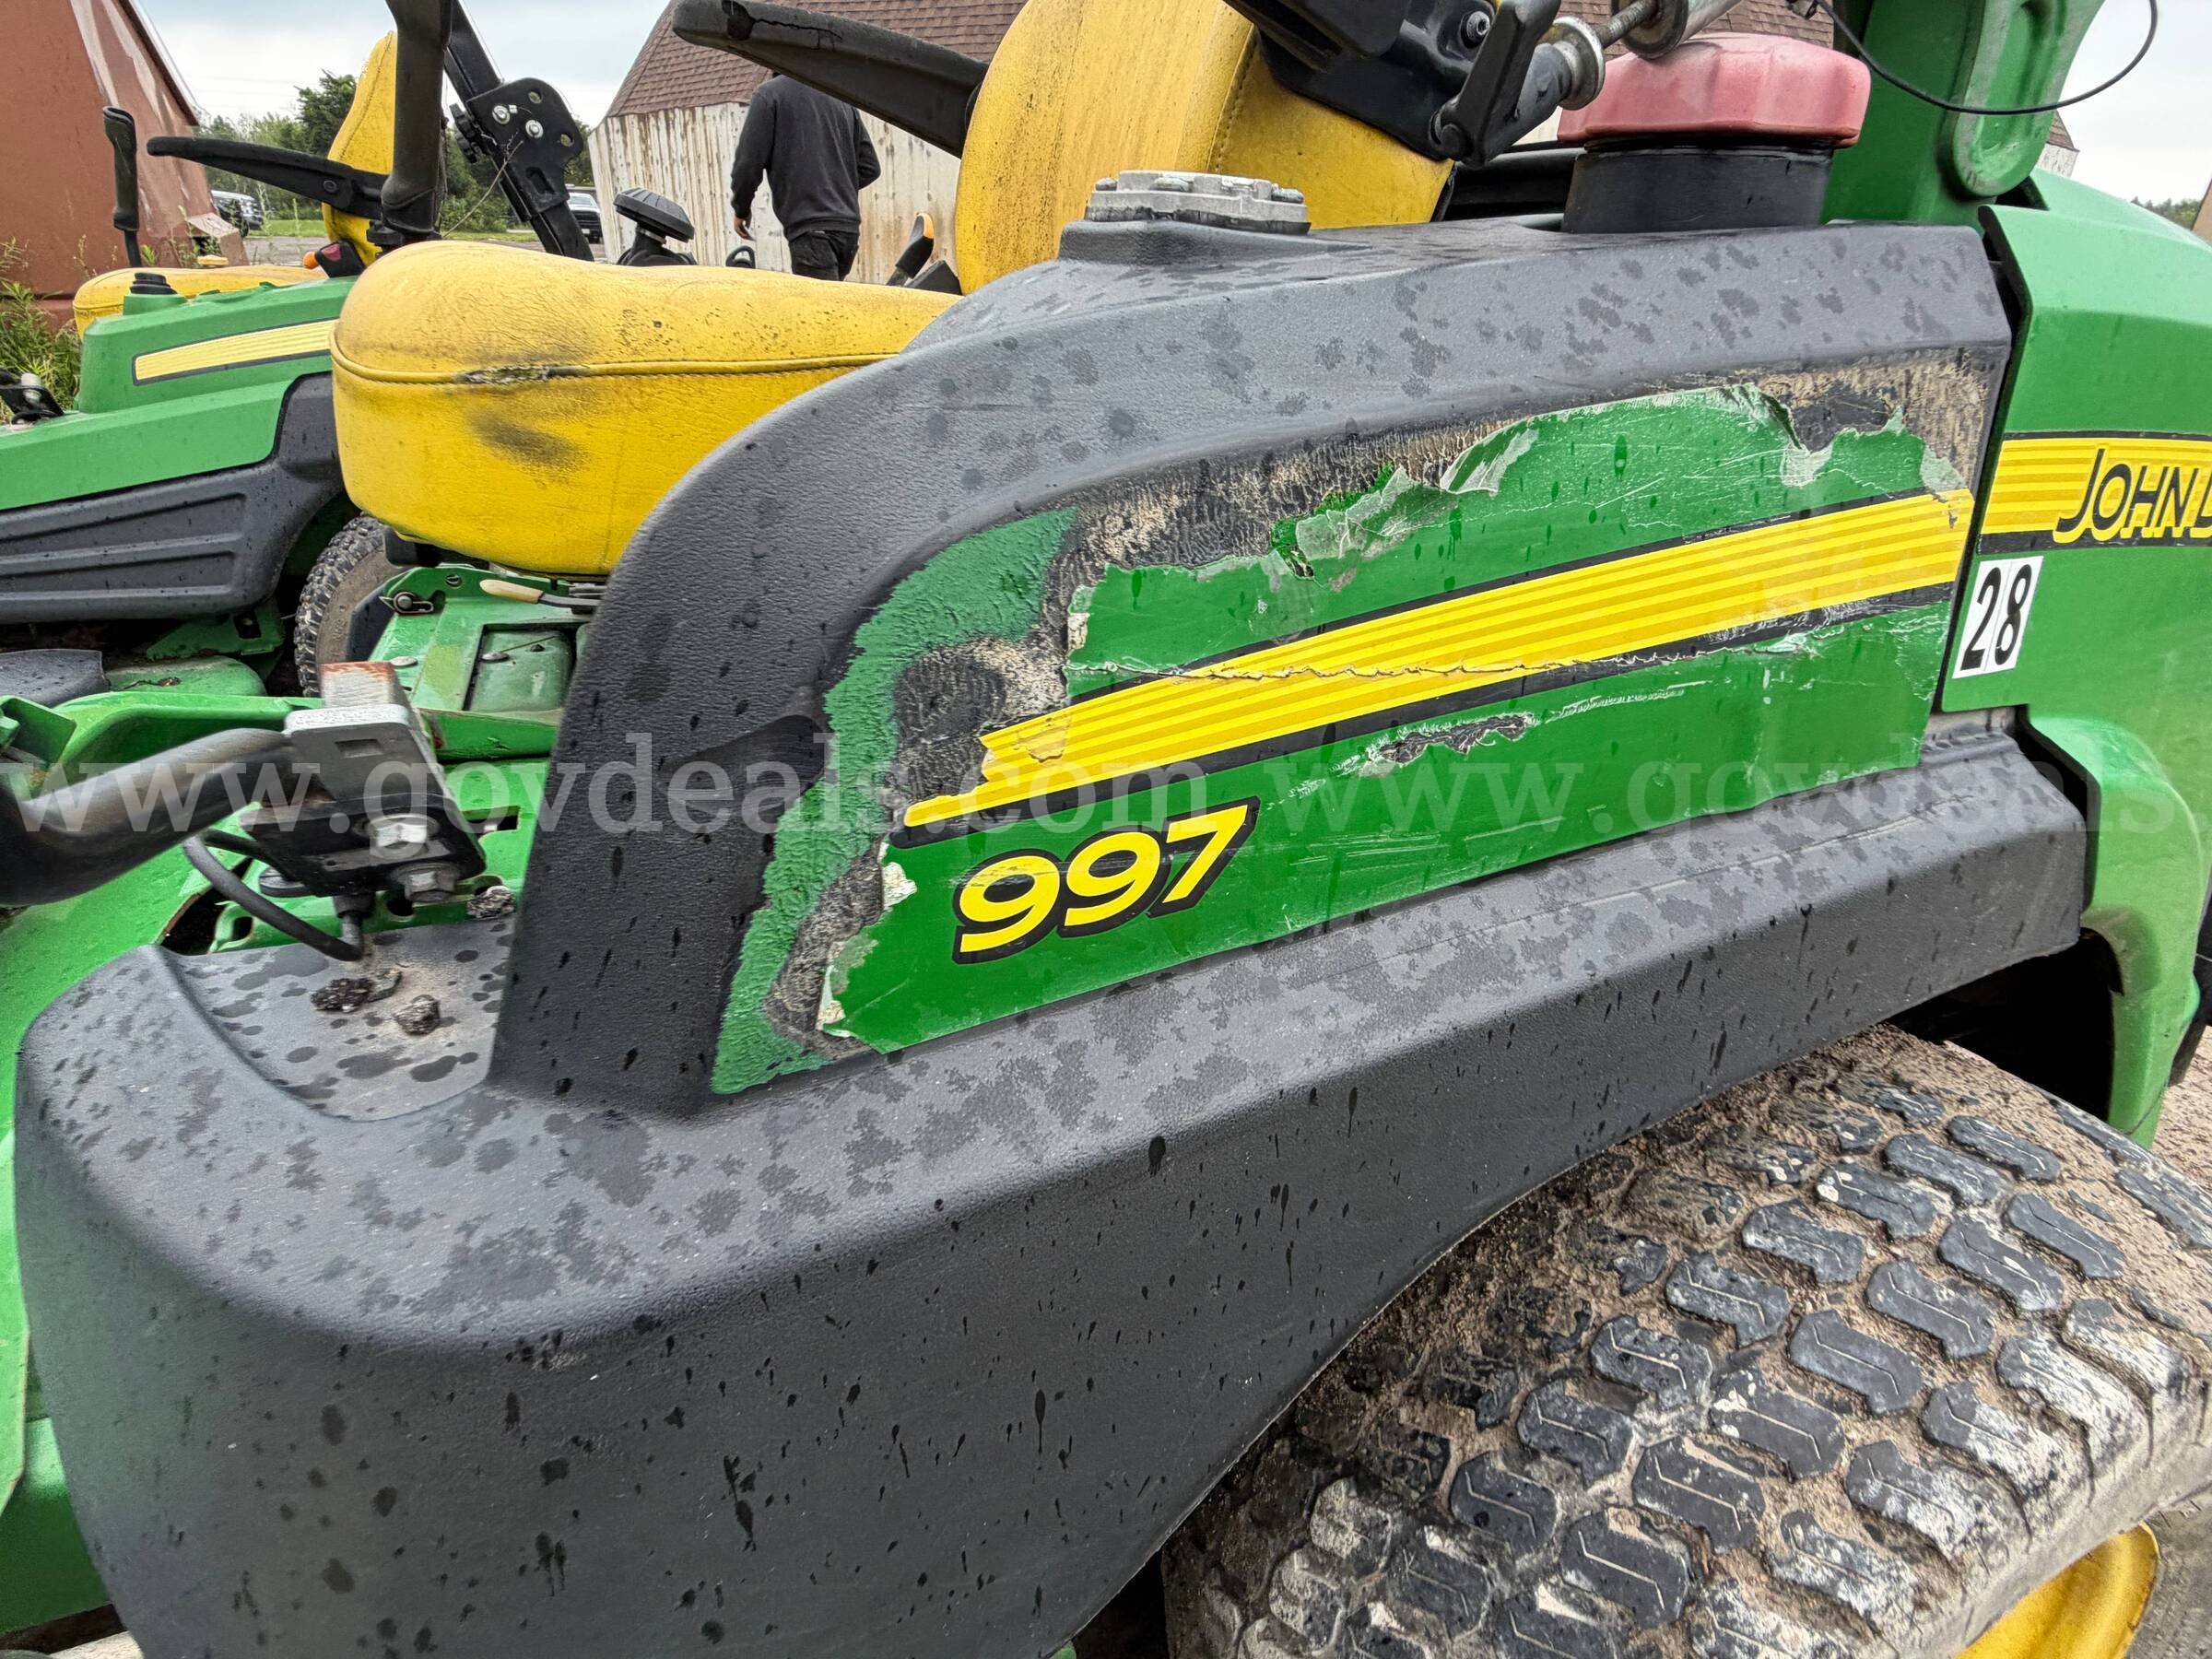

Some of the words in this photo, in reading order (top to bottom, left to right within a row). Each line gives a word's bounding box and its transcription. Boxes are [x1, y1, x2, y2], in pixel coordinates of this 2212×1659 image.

[2054, 447, 2201, 541] JOHN
[1959, 564, 2032, 671] 28
[956, 800, 1255, 959] 997
